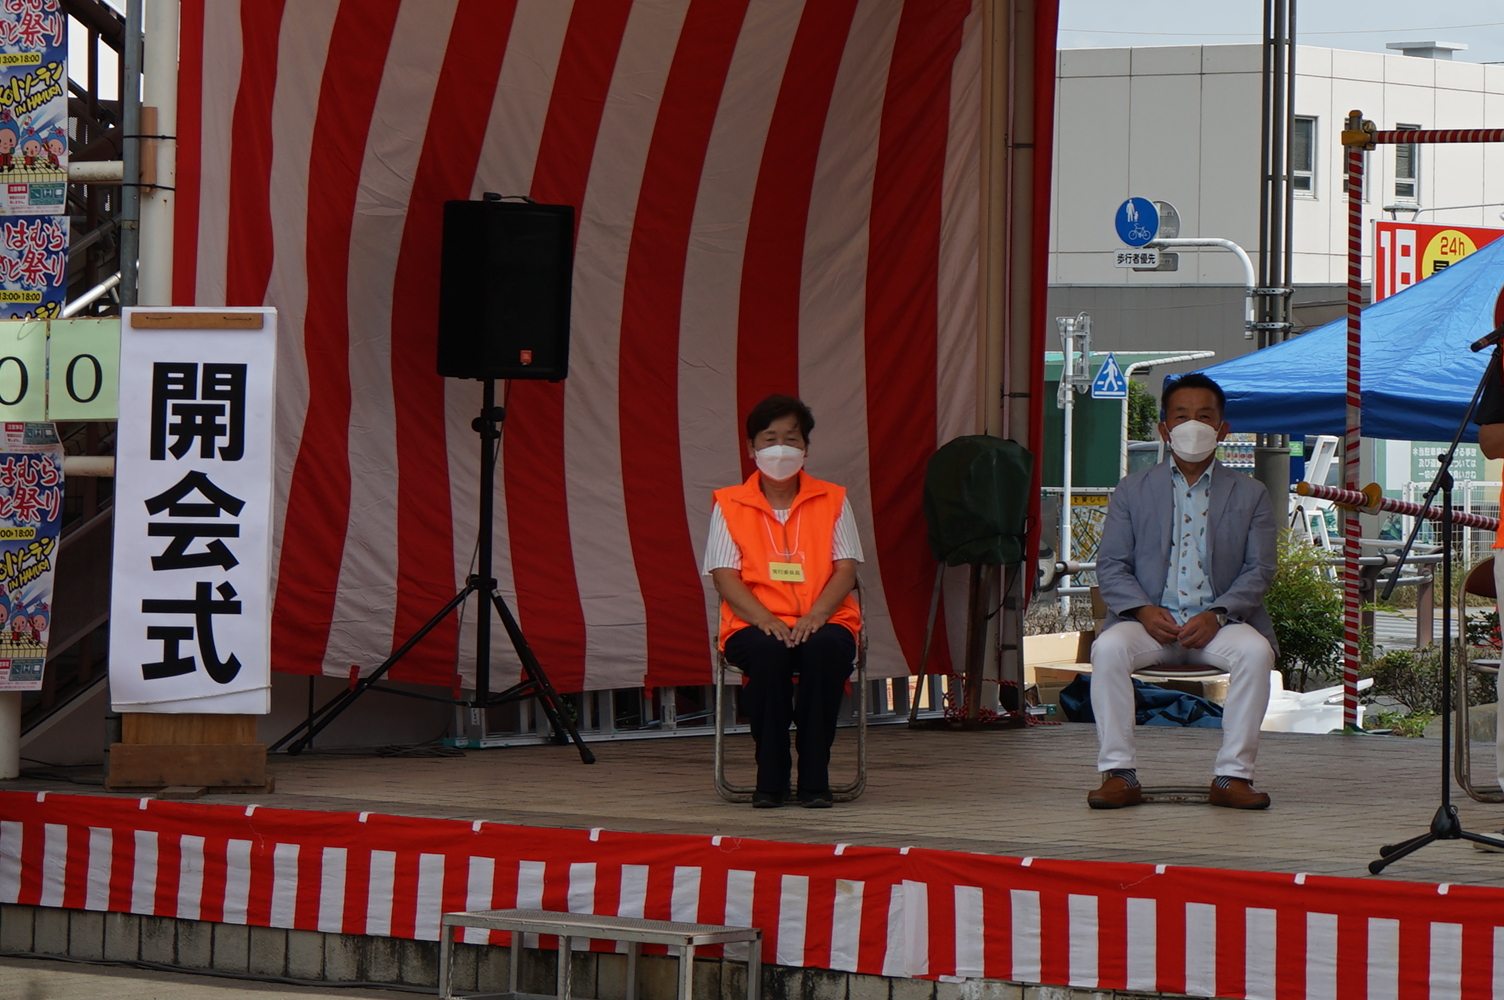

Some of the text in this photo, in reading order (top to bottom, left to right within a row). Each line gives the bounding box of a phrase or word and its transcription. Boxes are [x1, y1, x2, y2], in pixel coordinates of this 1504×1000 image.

[5, 219, 64, 251] はむら
[1440, 236, 1465, 256] 24h
[141, 362, 246, 684] 開会式
